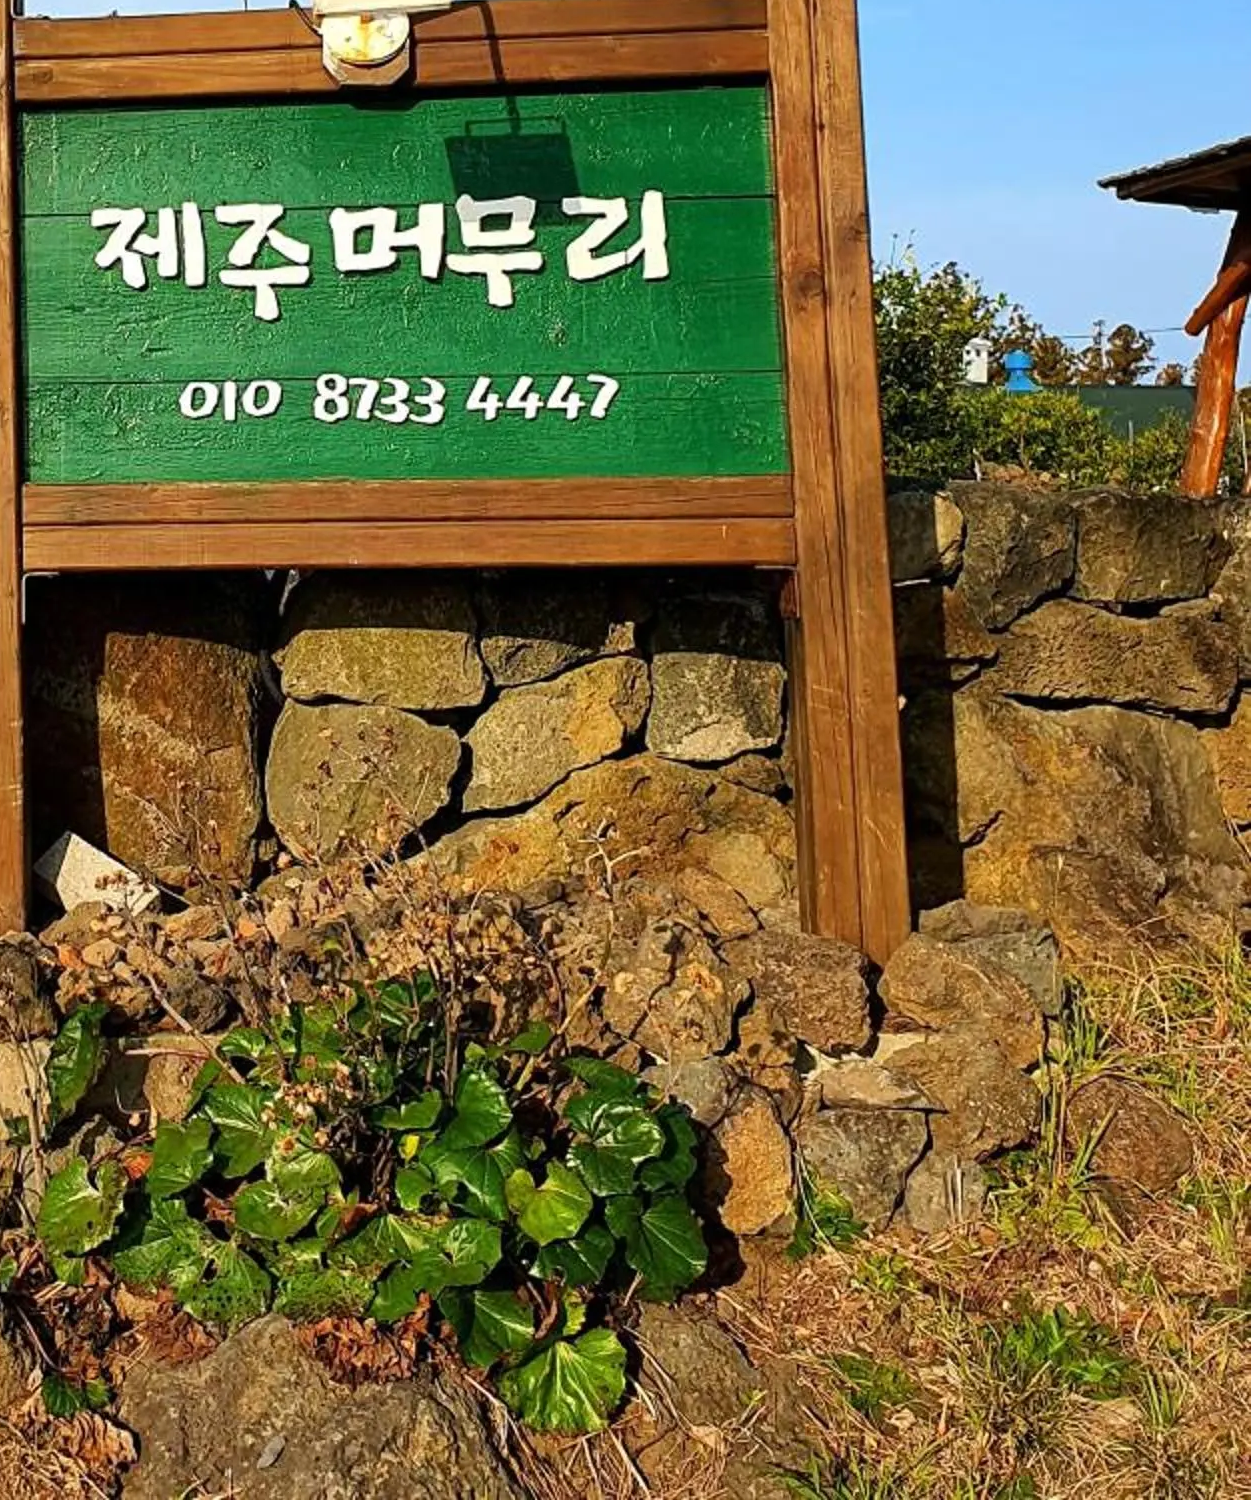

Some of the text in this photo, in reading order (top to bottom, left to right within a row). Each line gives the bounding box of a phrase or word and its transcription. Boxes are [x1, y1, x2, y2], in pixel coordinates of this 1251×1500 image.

[178, 373, 620, 424] 010 8733 4447
